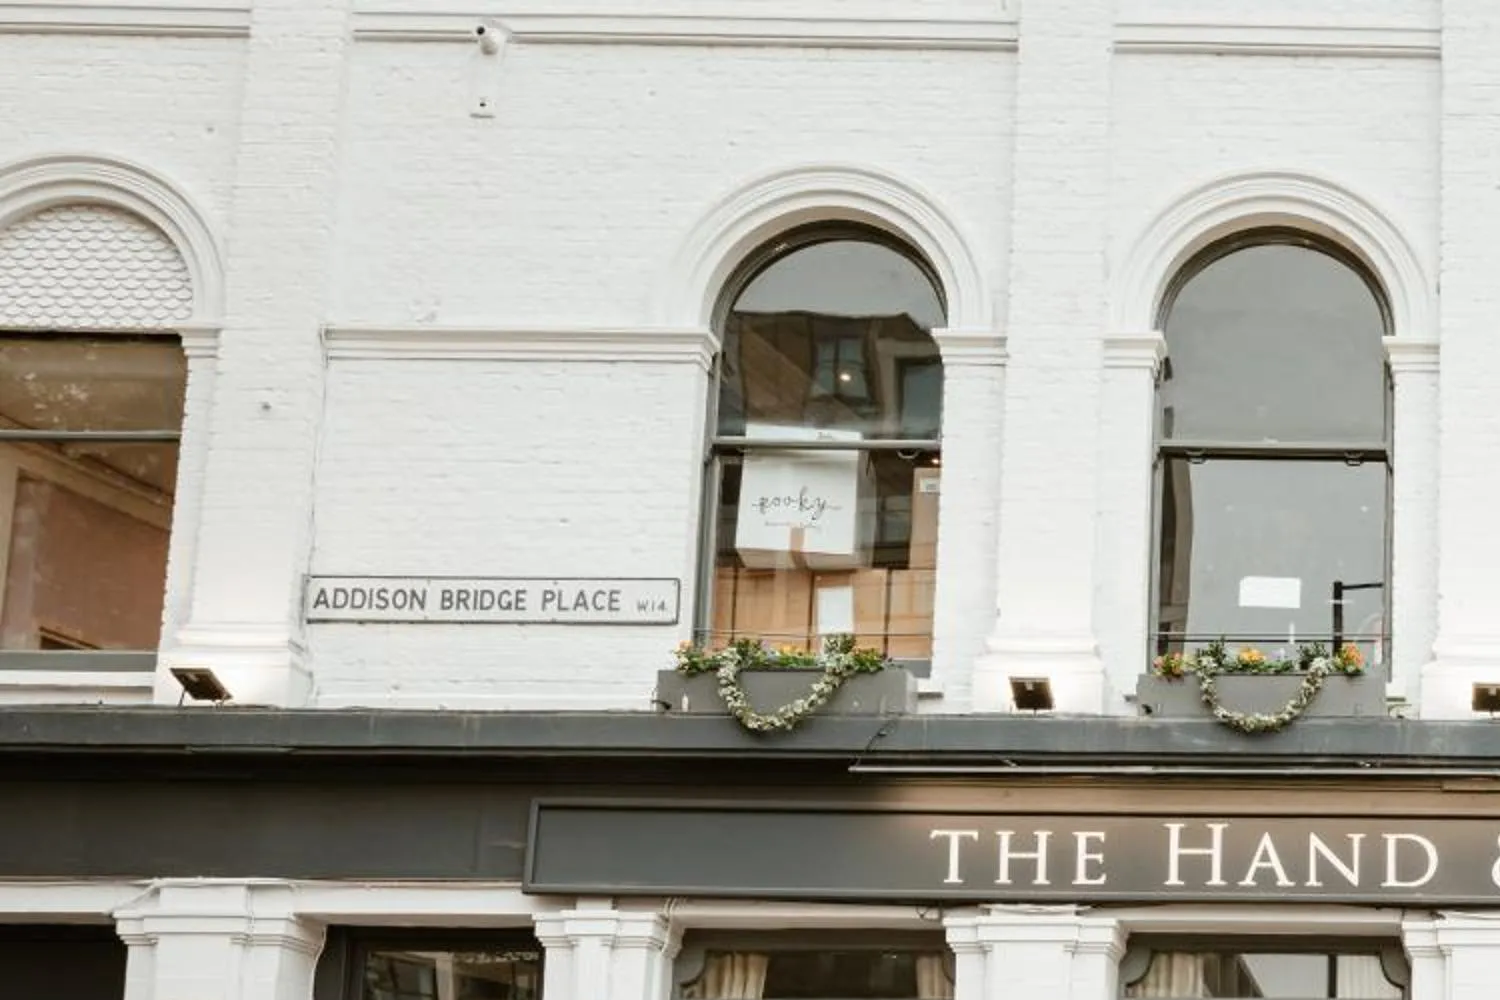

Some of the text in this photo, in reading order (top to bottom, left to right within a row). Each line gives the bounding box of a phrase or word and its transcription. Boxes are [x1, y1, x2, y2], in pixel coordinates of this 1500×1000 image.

[313, 586, 428, 611] ADDISON
[440, 588, 528, 612] BRIDGE
[541, 590, 621, 612] PLACE
[930, 828, 1107, 886] THE
[1164, 822, 1439, 888] HAND
